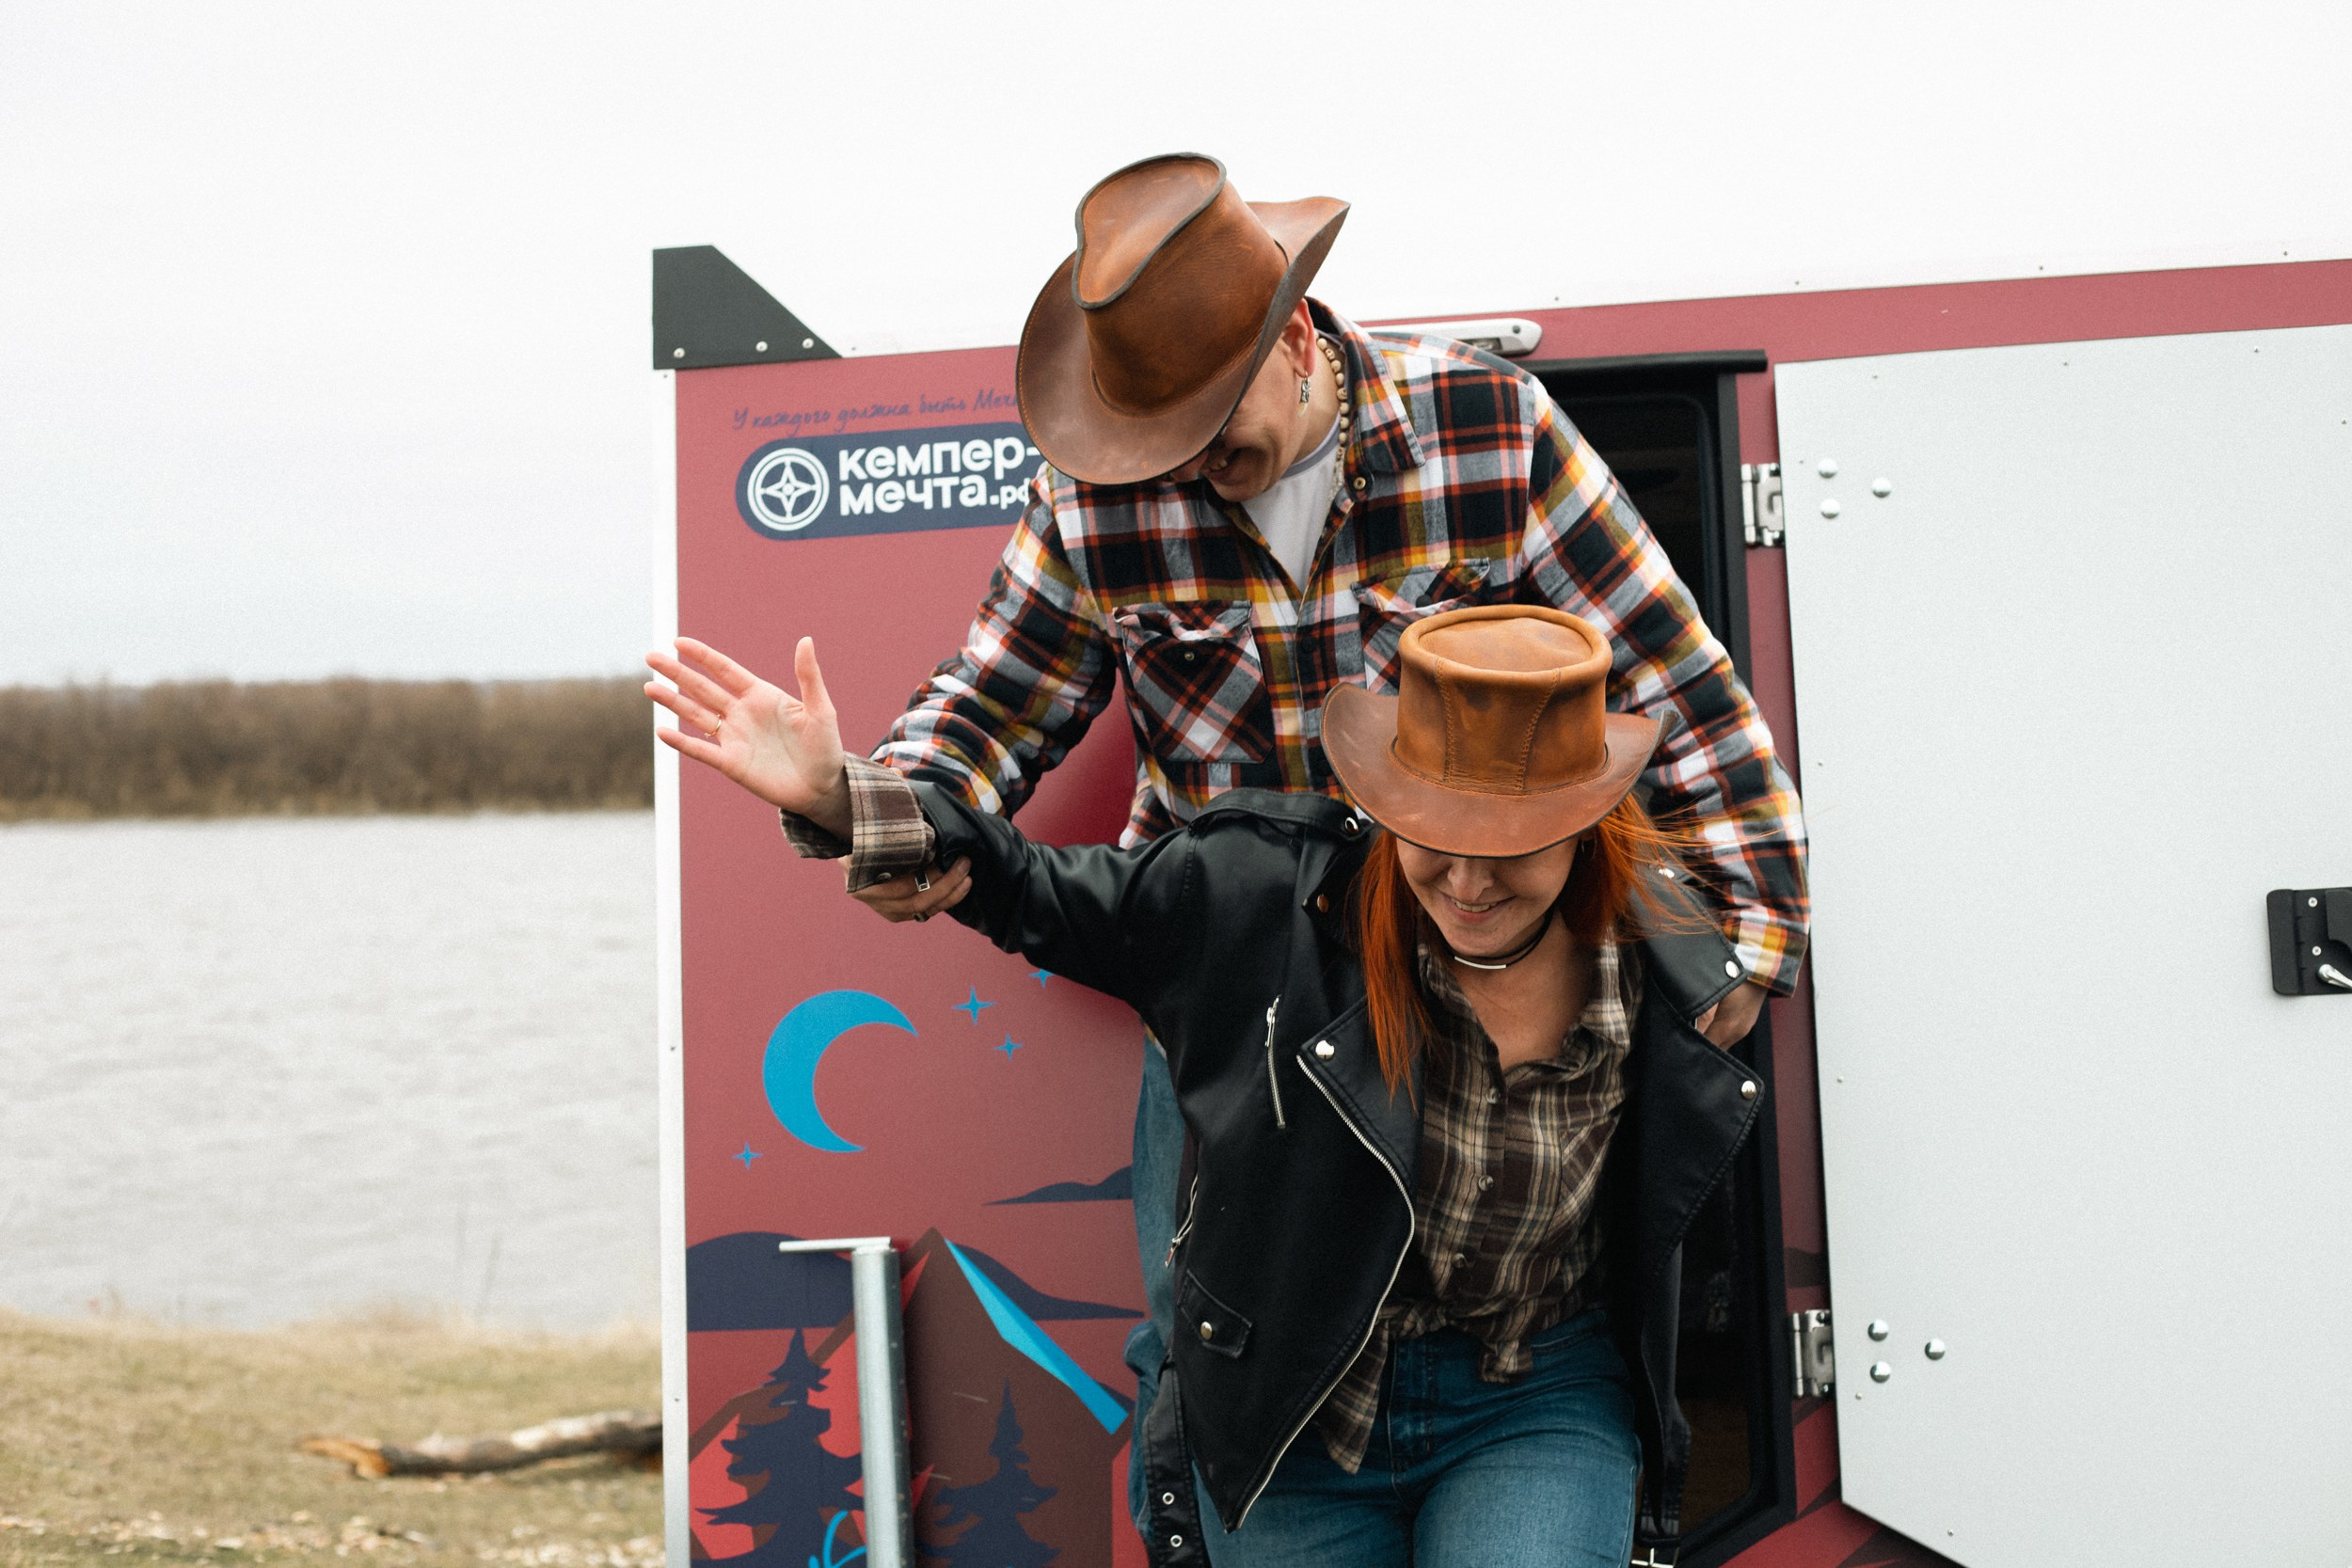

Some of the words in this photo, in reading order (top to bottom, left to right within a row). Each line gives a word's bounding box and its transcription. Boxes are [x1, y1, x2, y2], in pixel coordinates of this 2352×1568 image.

[733, 406, 749, 431] У
[753, 410, 831, 437] каждого
[834, 403, 911, 433] должна
[918, 393, 966, 414] быть
